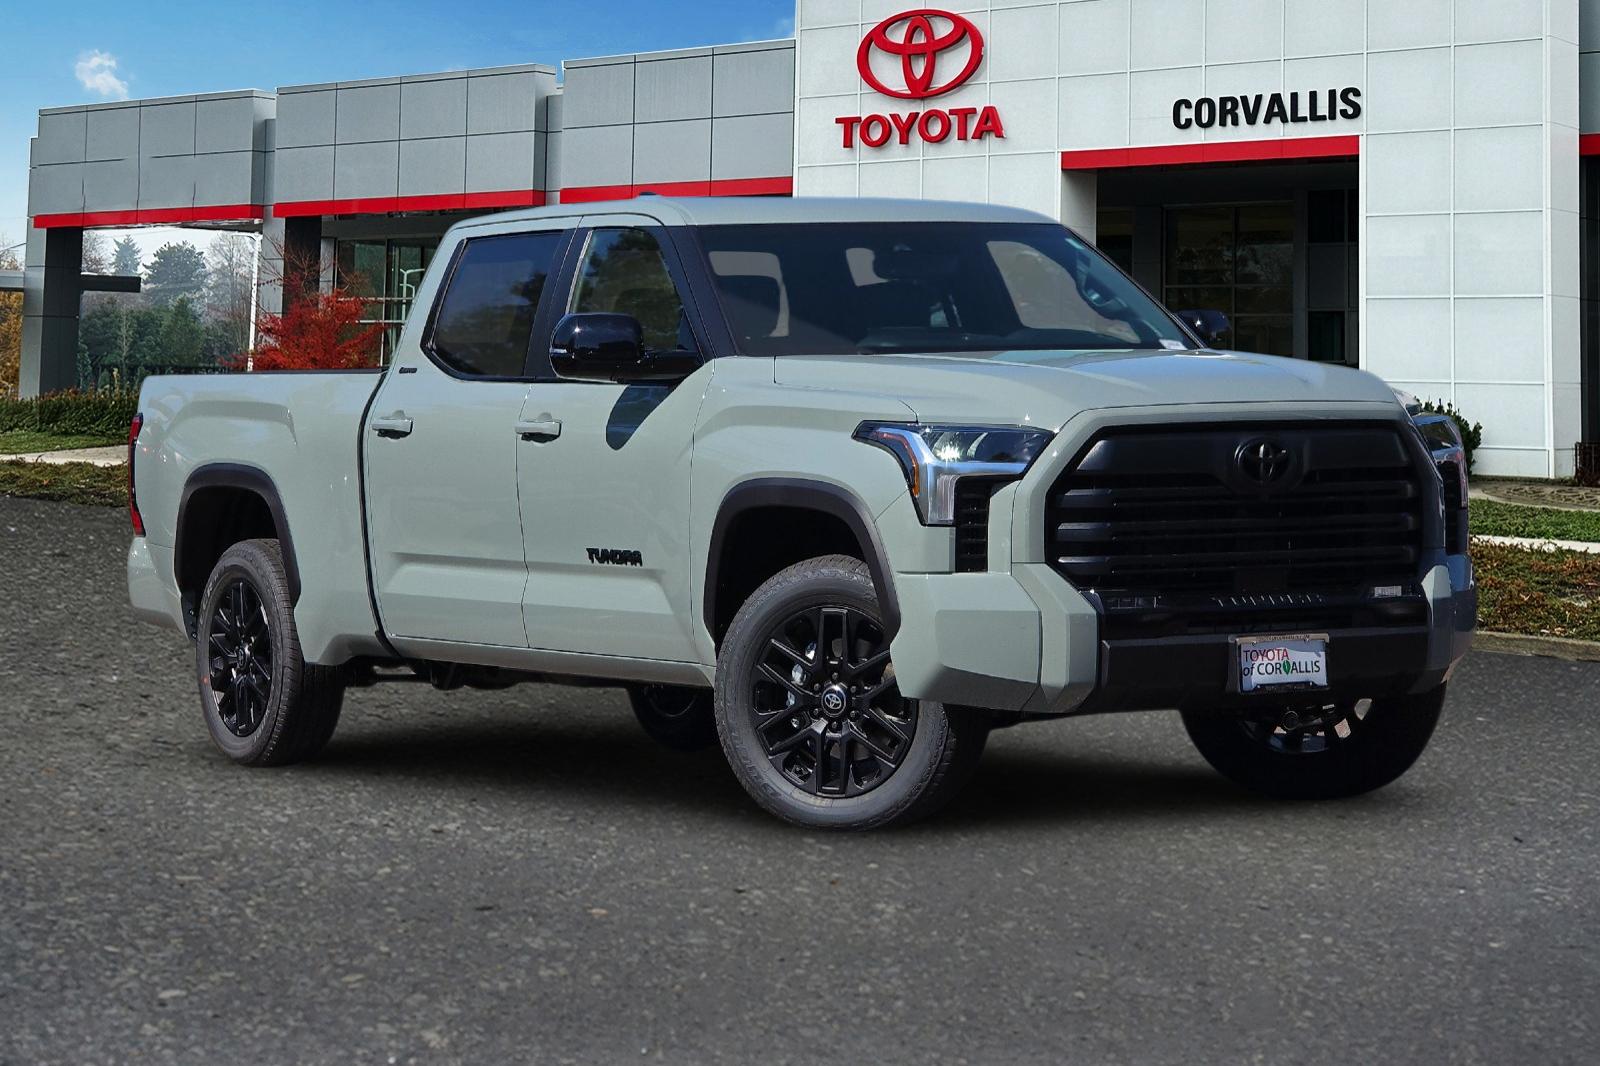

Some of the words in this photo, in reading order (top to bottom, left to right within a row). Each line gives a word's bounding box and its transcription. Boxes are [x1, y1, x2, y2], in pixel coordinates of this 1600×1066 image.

[1172, 87, 1361, 130] CORVALLIS
[836, 106, 1005, 149] TOYOTA
[586, 548, 643, 567] TUNDRA
[1243, 648, 1289, 662] TOYOTA
[1243, 663, 1255, 676] of
